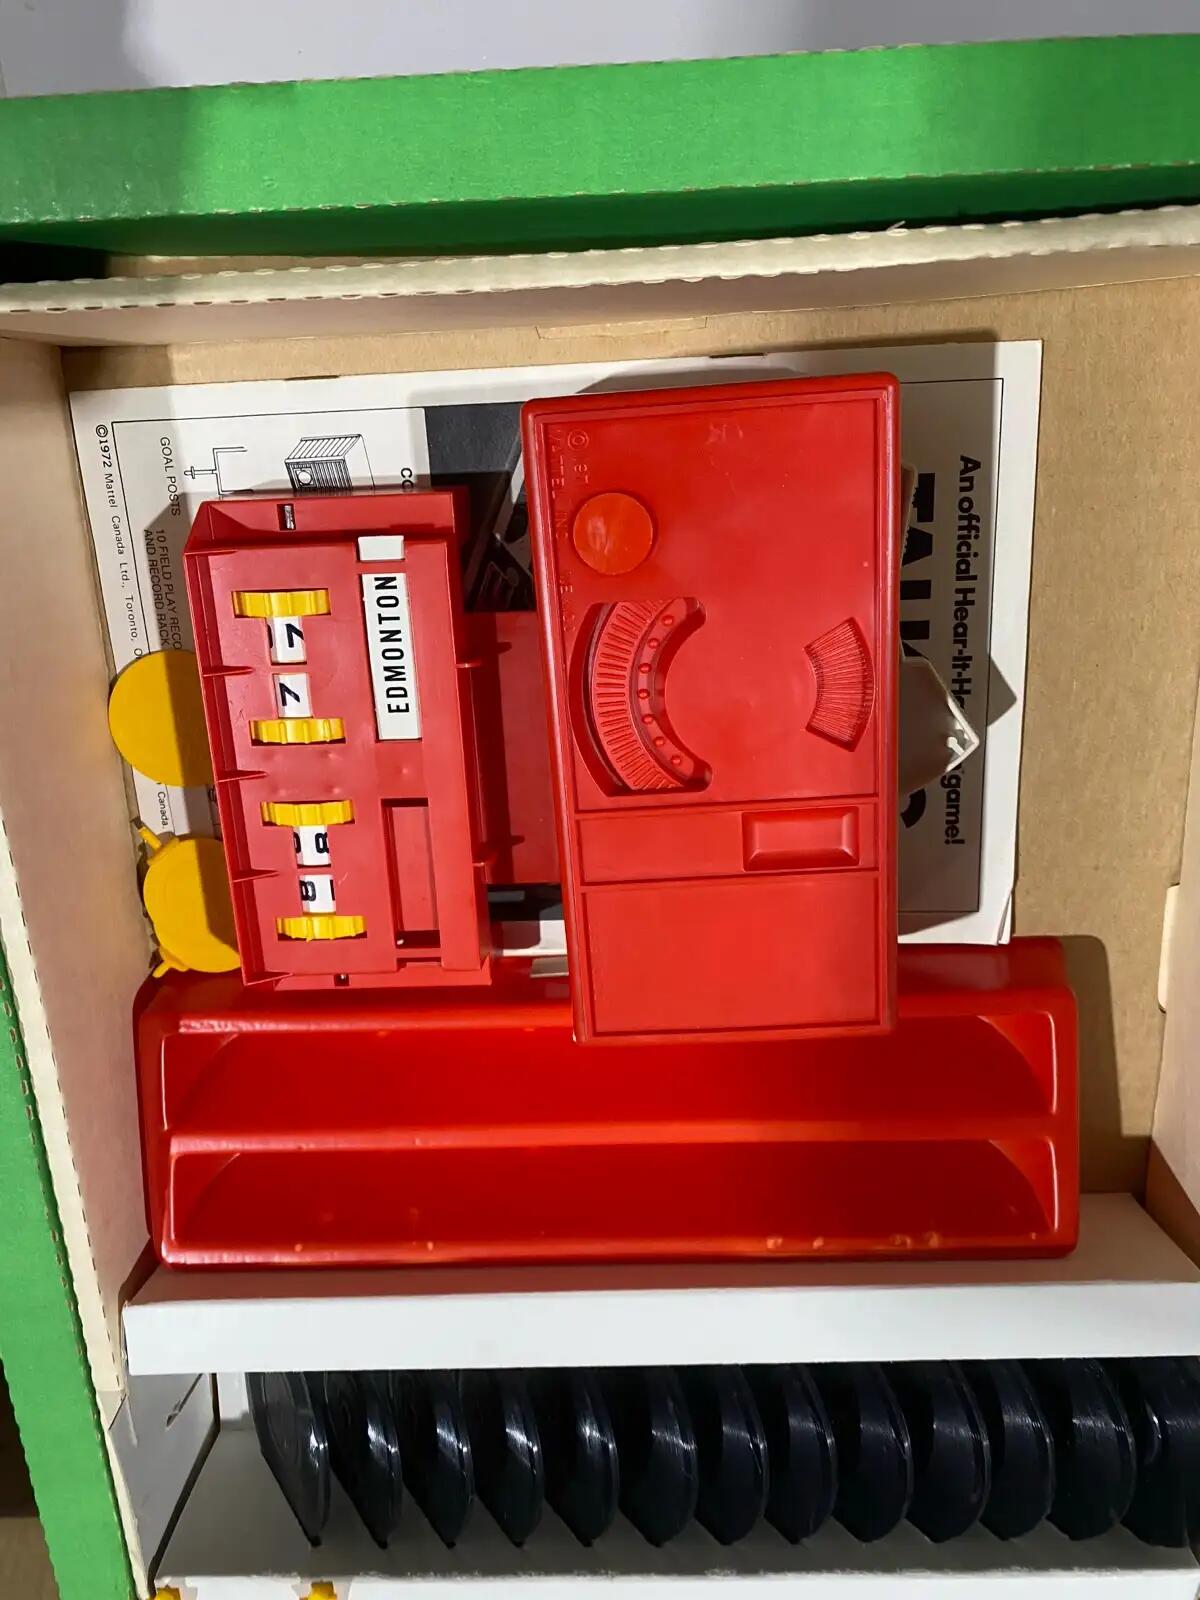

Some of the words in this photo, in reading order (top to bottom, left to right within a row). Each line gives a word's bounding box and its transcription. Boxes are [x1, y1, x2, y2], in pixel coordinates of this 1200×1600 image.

[160, 436, 175, 472] GOAL
[959, 455, 982, 492] An
[166, 476, 181, 516] POSTS
[144, 529, 157, 556] AND
[155, 529, 167, 543] 10
[956, 496, 981, 581] official
[104, 473, 118, 508] Mattel
[111, 515, 125, 555] Canada
[125, 595, 138, 641] Toronto,
[159, 546, 172, 580] FIELD
[149, 559, 164, 609] RECORD
[164, 583, 178, 612] PLAY
[156, 613, 170, 647] RACK
[170, 616, 182, 650] RECO
[373, 576, 410, 714] EDMONTON
[279, 682, 301, 707] 7
[940, 774, 966, 845] game!
